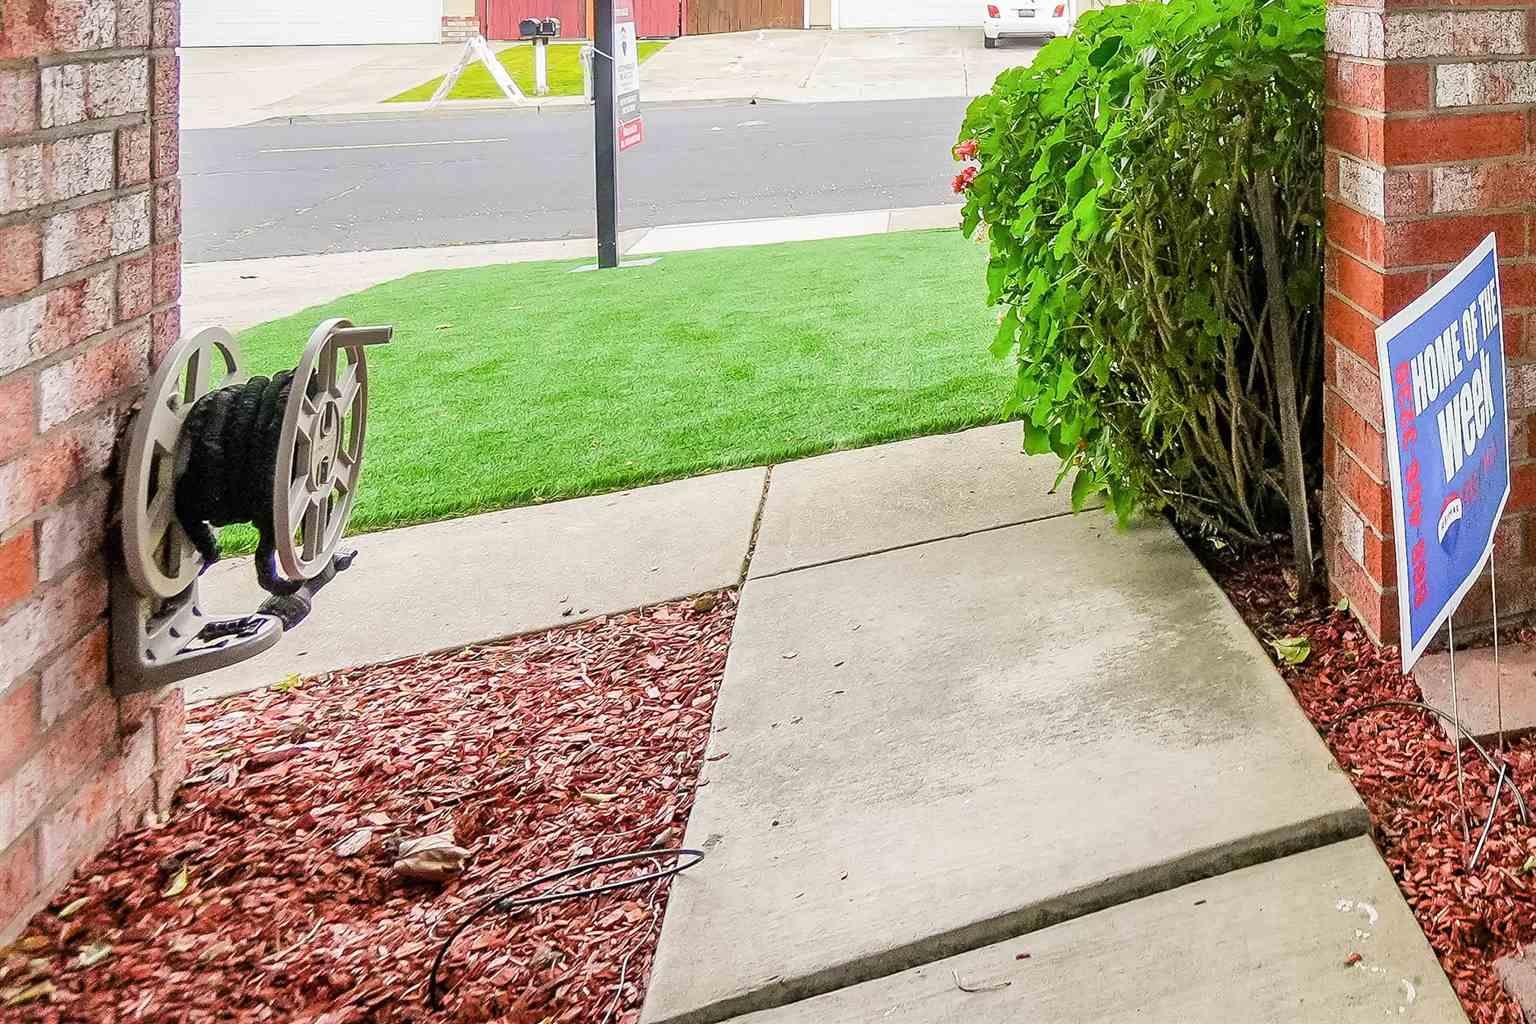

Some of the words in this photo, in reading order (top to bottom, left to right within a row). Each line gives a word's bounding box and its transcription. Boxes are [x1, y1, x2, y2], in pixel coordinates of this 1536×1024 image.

[1410, 320, 1463, 417] HOME
[1462, 301, 1478, 361] OF
[1477, 278, 1498, 341] THE
